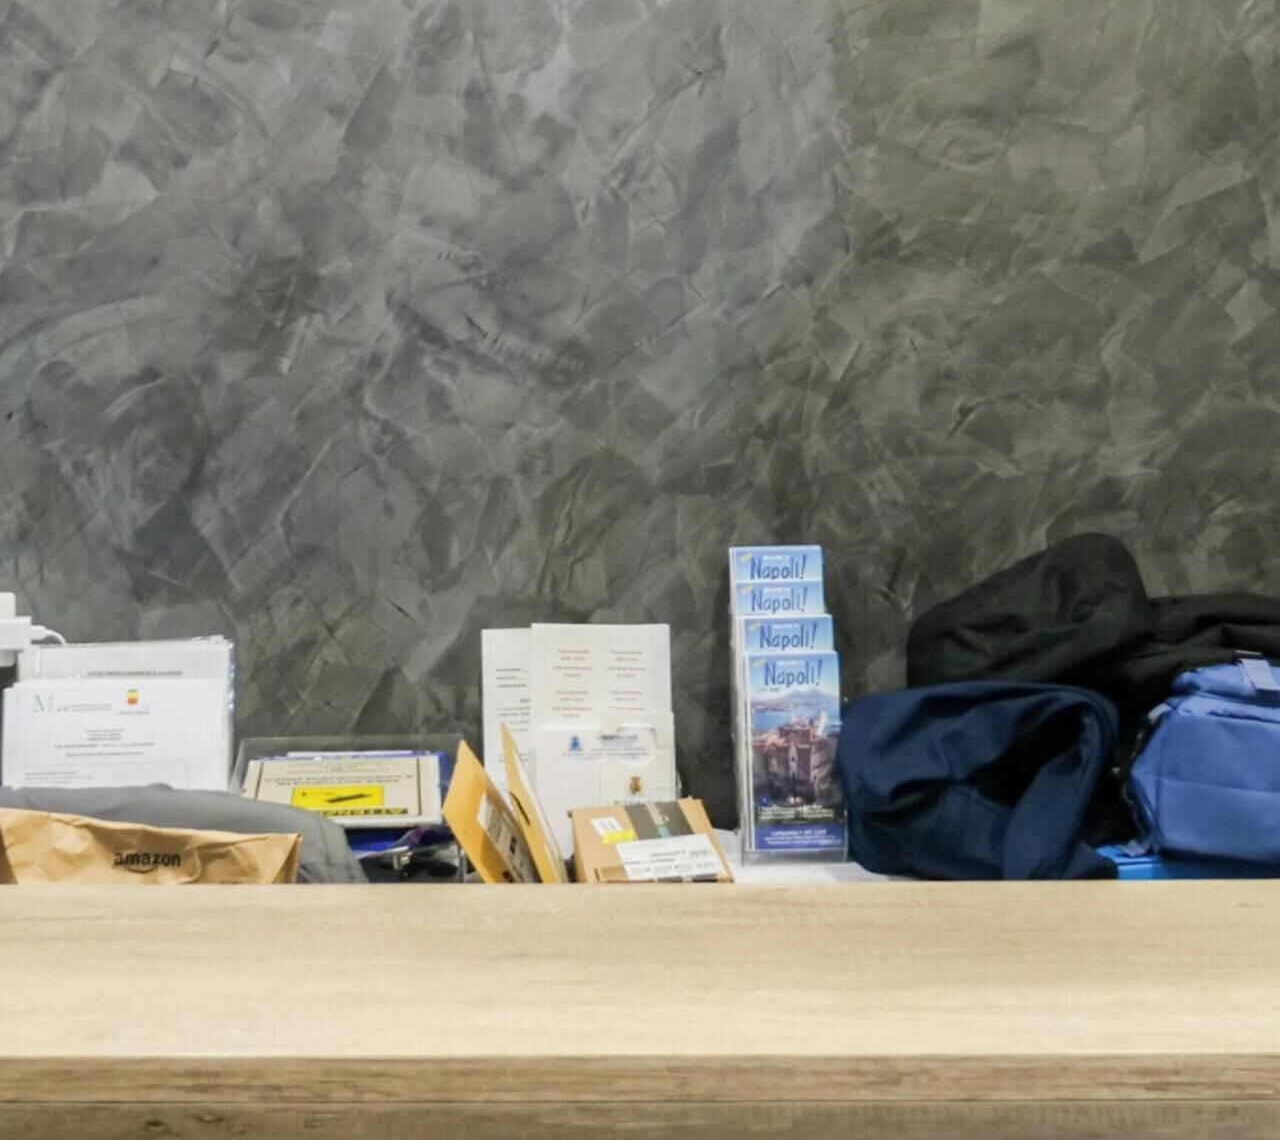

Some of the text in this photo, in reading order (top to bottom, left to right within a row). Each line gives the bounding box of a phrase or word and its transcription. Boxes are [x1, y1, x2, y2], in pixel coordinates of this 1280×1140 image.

[751, 554, 807, 580] Napoli!
[751, 586, 807, 614] Napoli!
[760, 623, 817, 650] Napoli!
[764, 659, 823, 688] Napoli!
[113, 851, 181, 868] amazon
